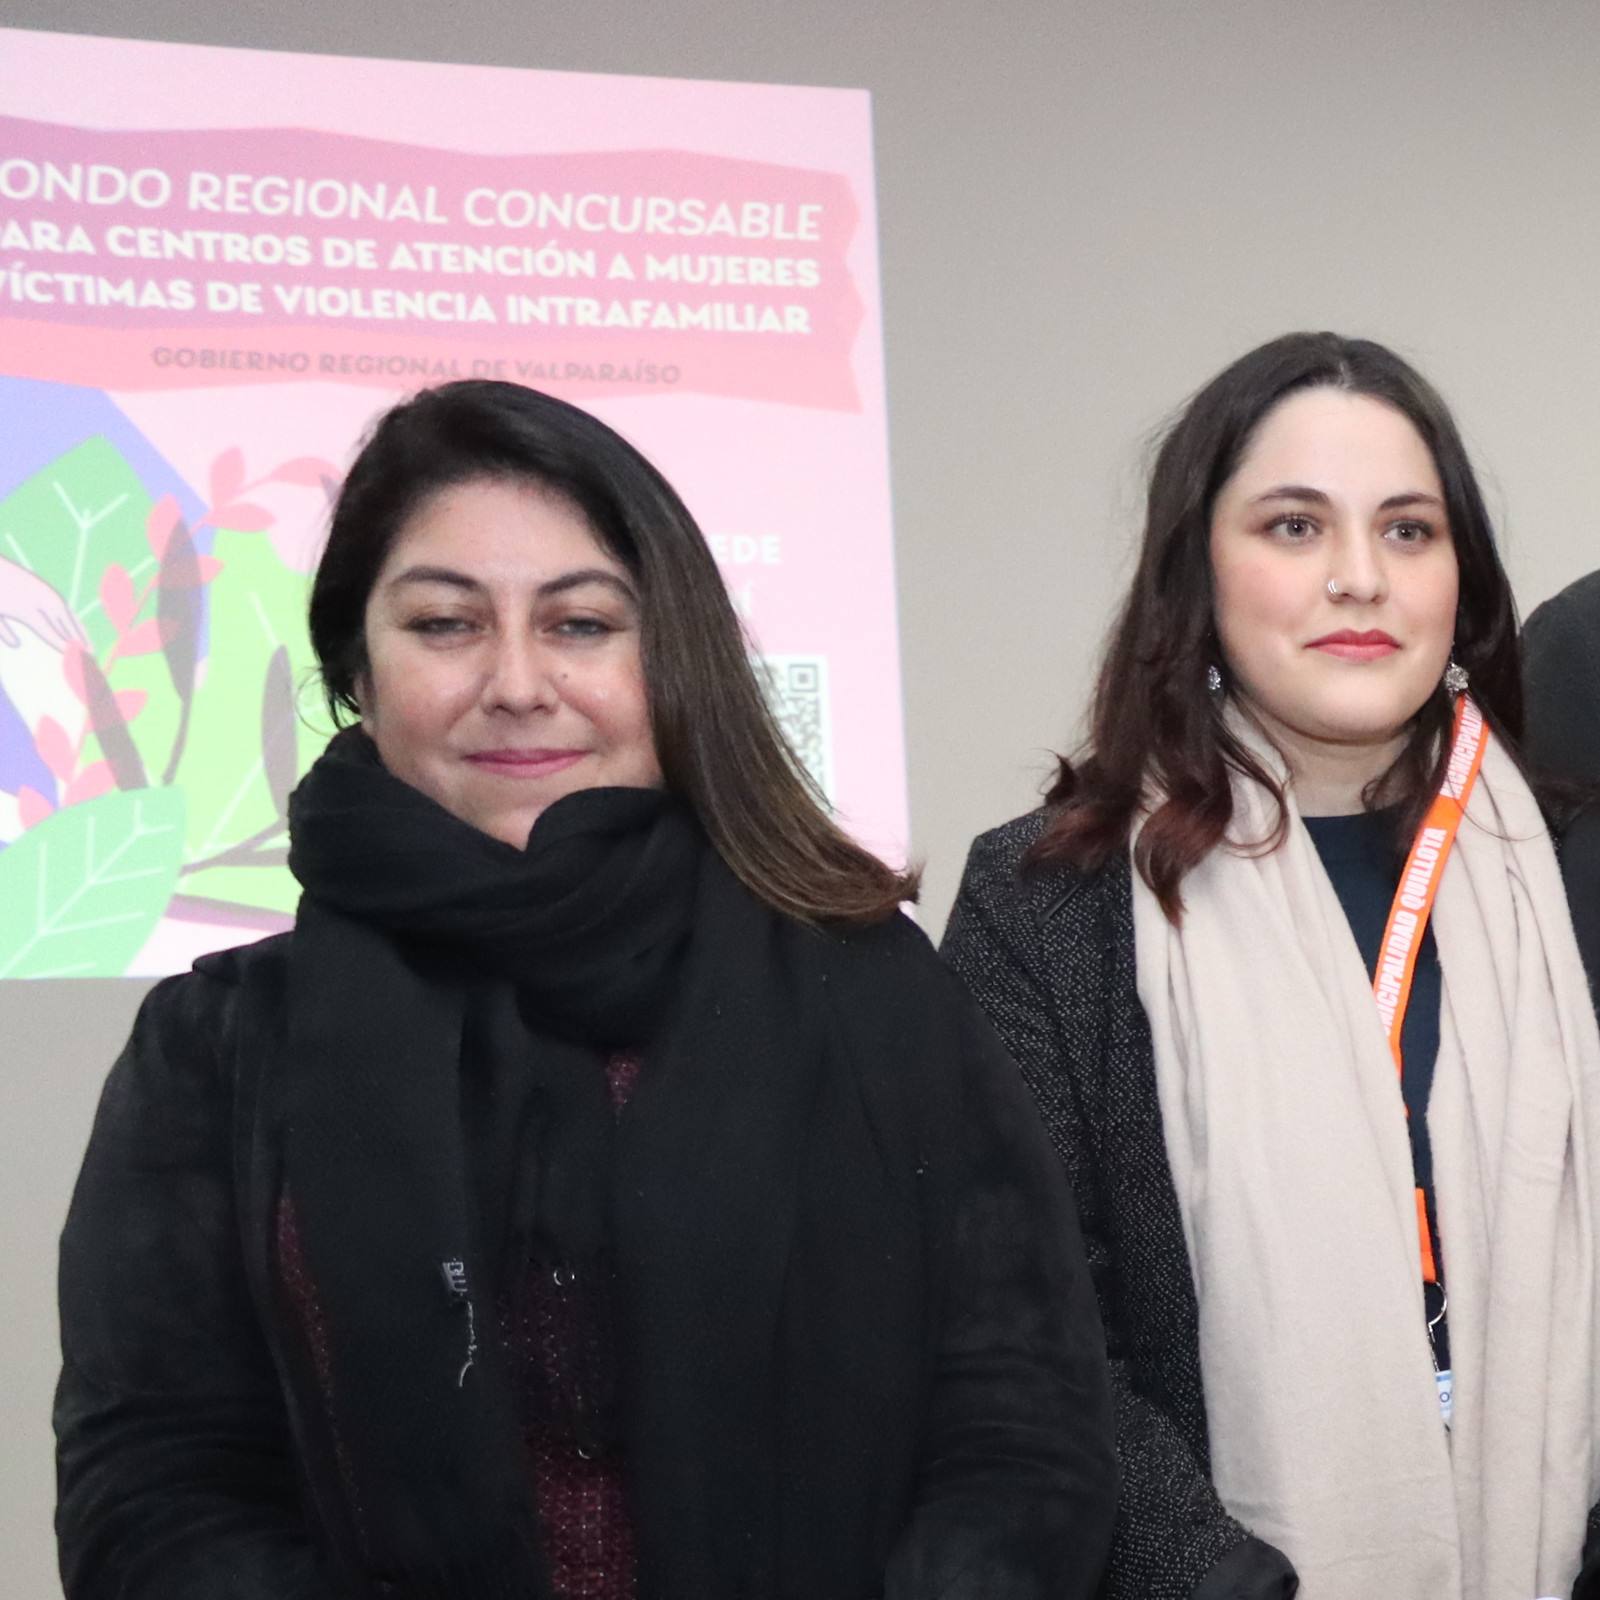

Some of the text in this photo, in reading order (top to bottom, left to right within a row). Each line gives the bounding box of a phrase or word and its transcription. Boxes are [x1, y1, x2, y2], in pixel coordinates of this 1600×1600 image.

[0, 158, 823, 242] ONDO REGIONAL CONCURSABLE
[0, 219, 821, 288] ARA CENTROS DE ATENCIÓN A MUJERES
[206, 280, 265, 314] DE
[272, 284, 498, 322] VIOLENCIA
[507, 294, 812, 335] INTRAFAMILIAR
[152, 346, 683, 385] GOBIERNO REGIONAL DE VALPARAÍSO
[1400, 827, 1448, 911] QUILLOTA
